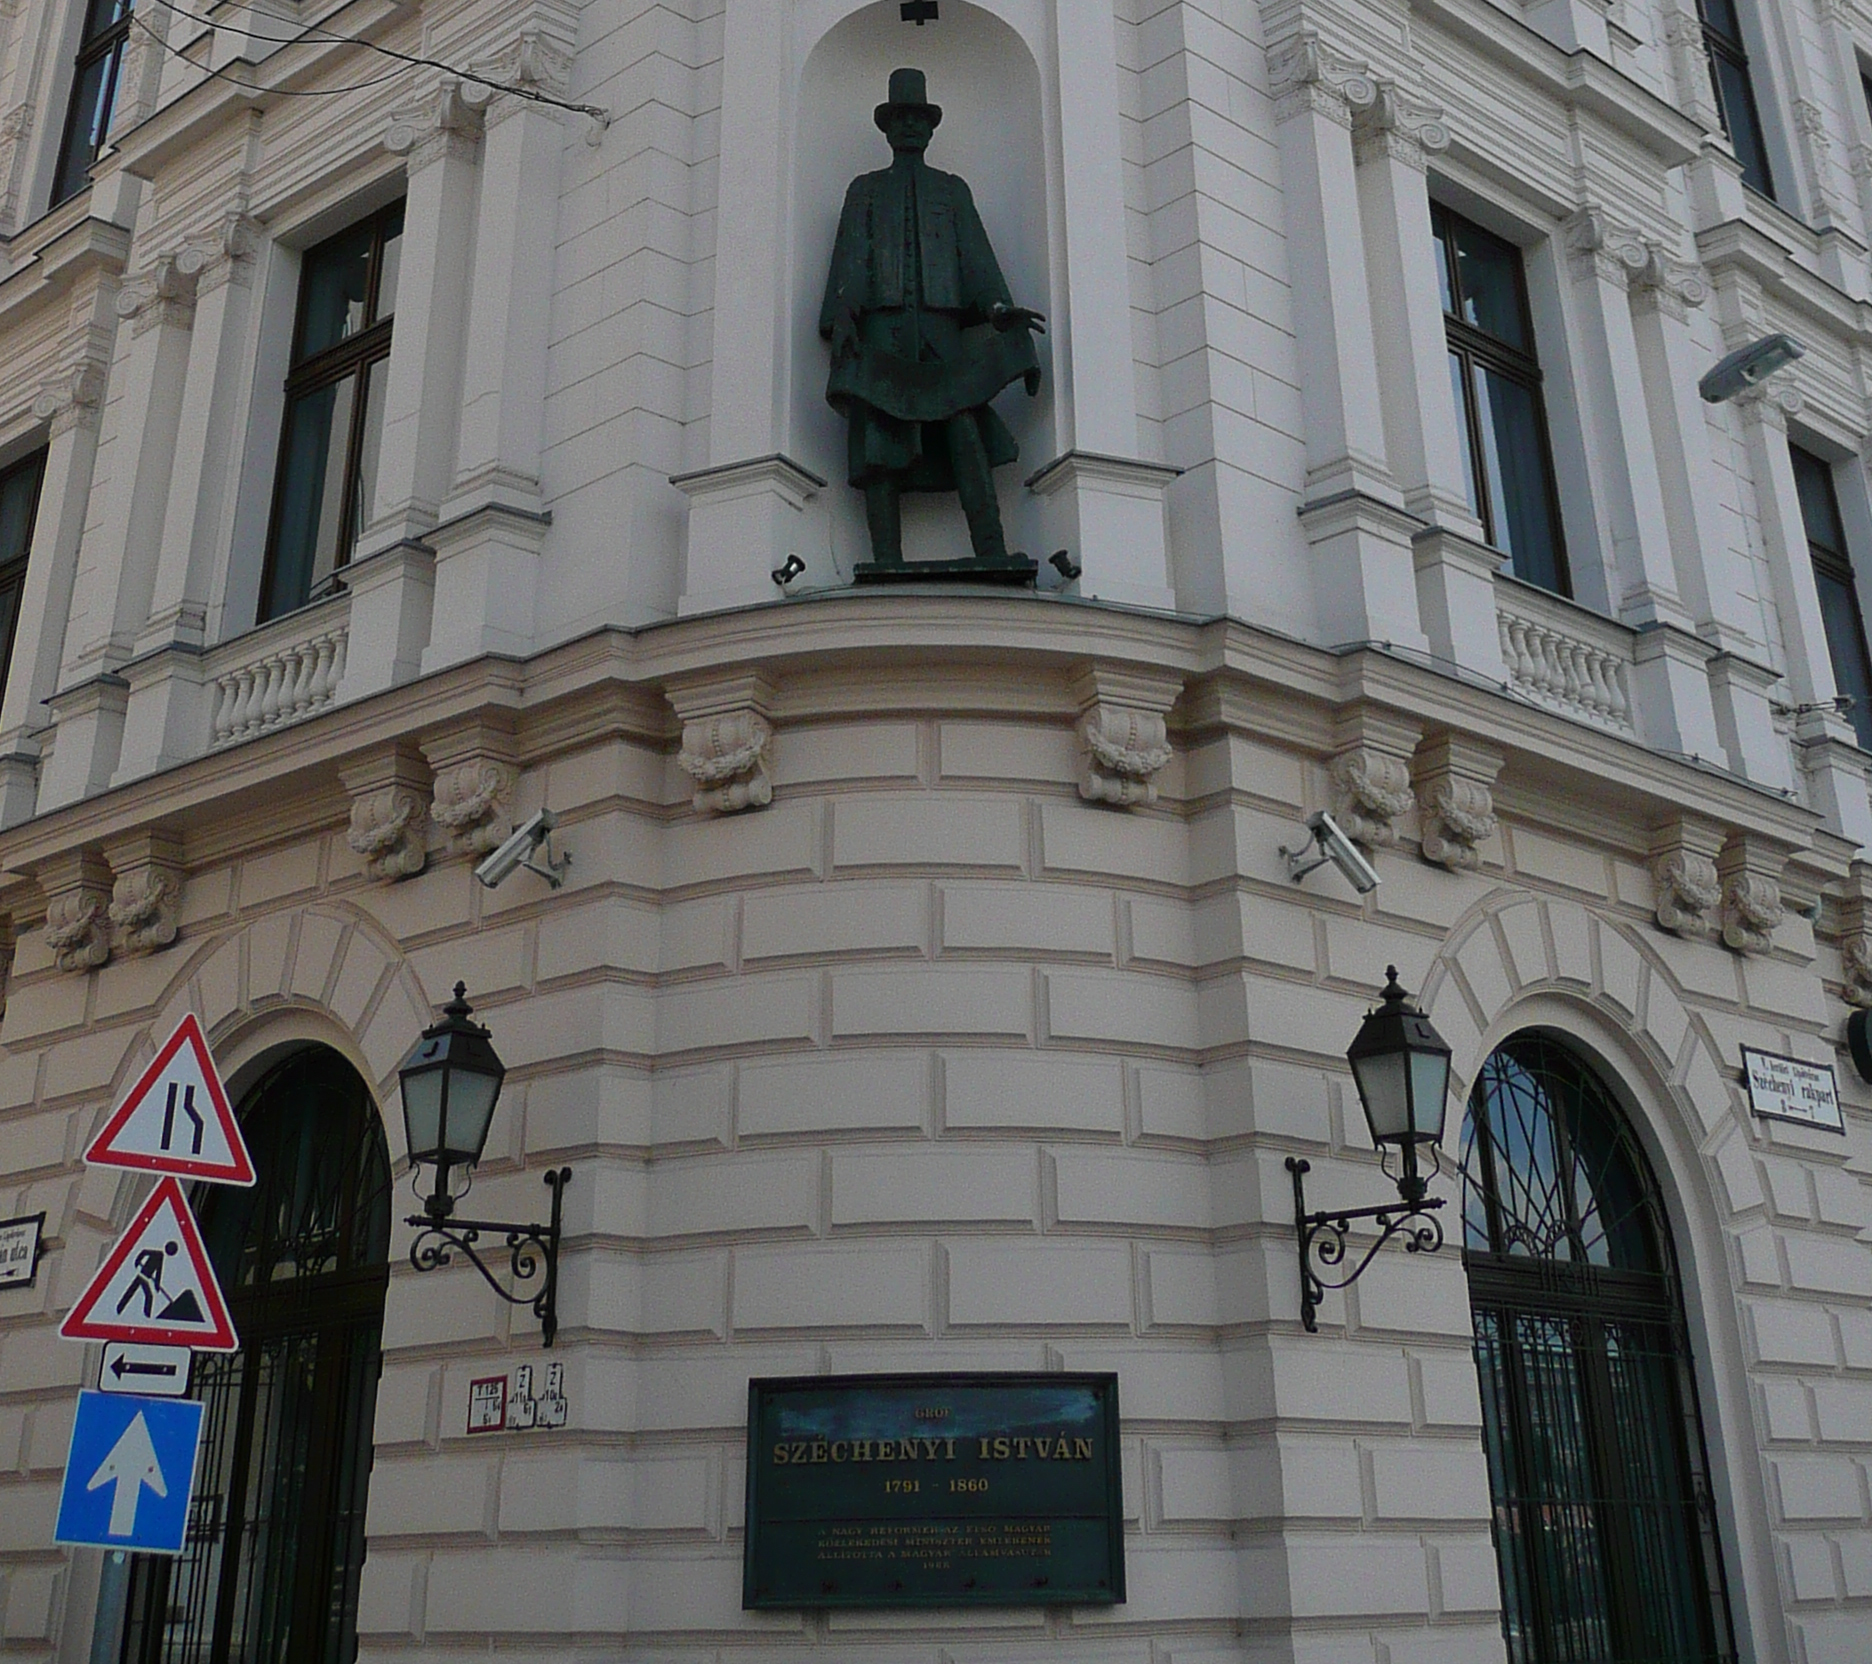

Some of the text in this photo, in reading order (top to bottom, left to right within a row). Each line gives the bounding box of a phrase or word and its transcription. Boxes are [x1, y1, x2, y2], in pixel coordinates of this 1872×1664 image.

[1761, 1057, 1769, 1070] V.
[1752, 1069, 1834, 1108] Széchenyi rakpart
[772, 1430, 1095, 1465] SZÉCHENYI ISTVÁN
[884, 1479, 921, 1493] 1791
[949, 1478, 990, 1493] 1860
